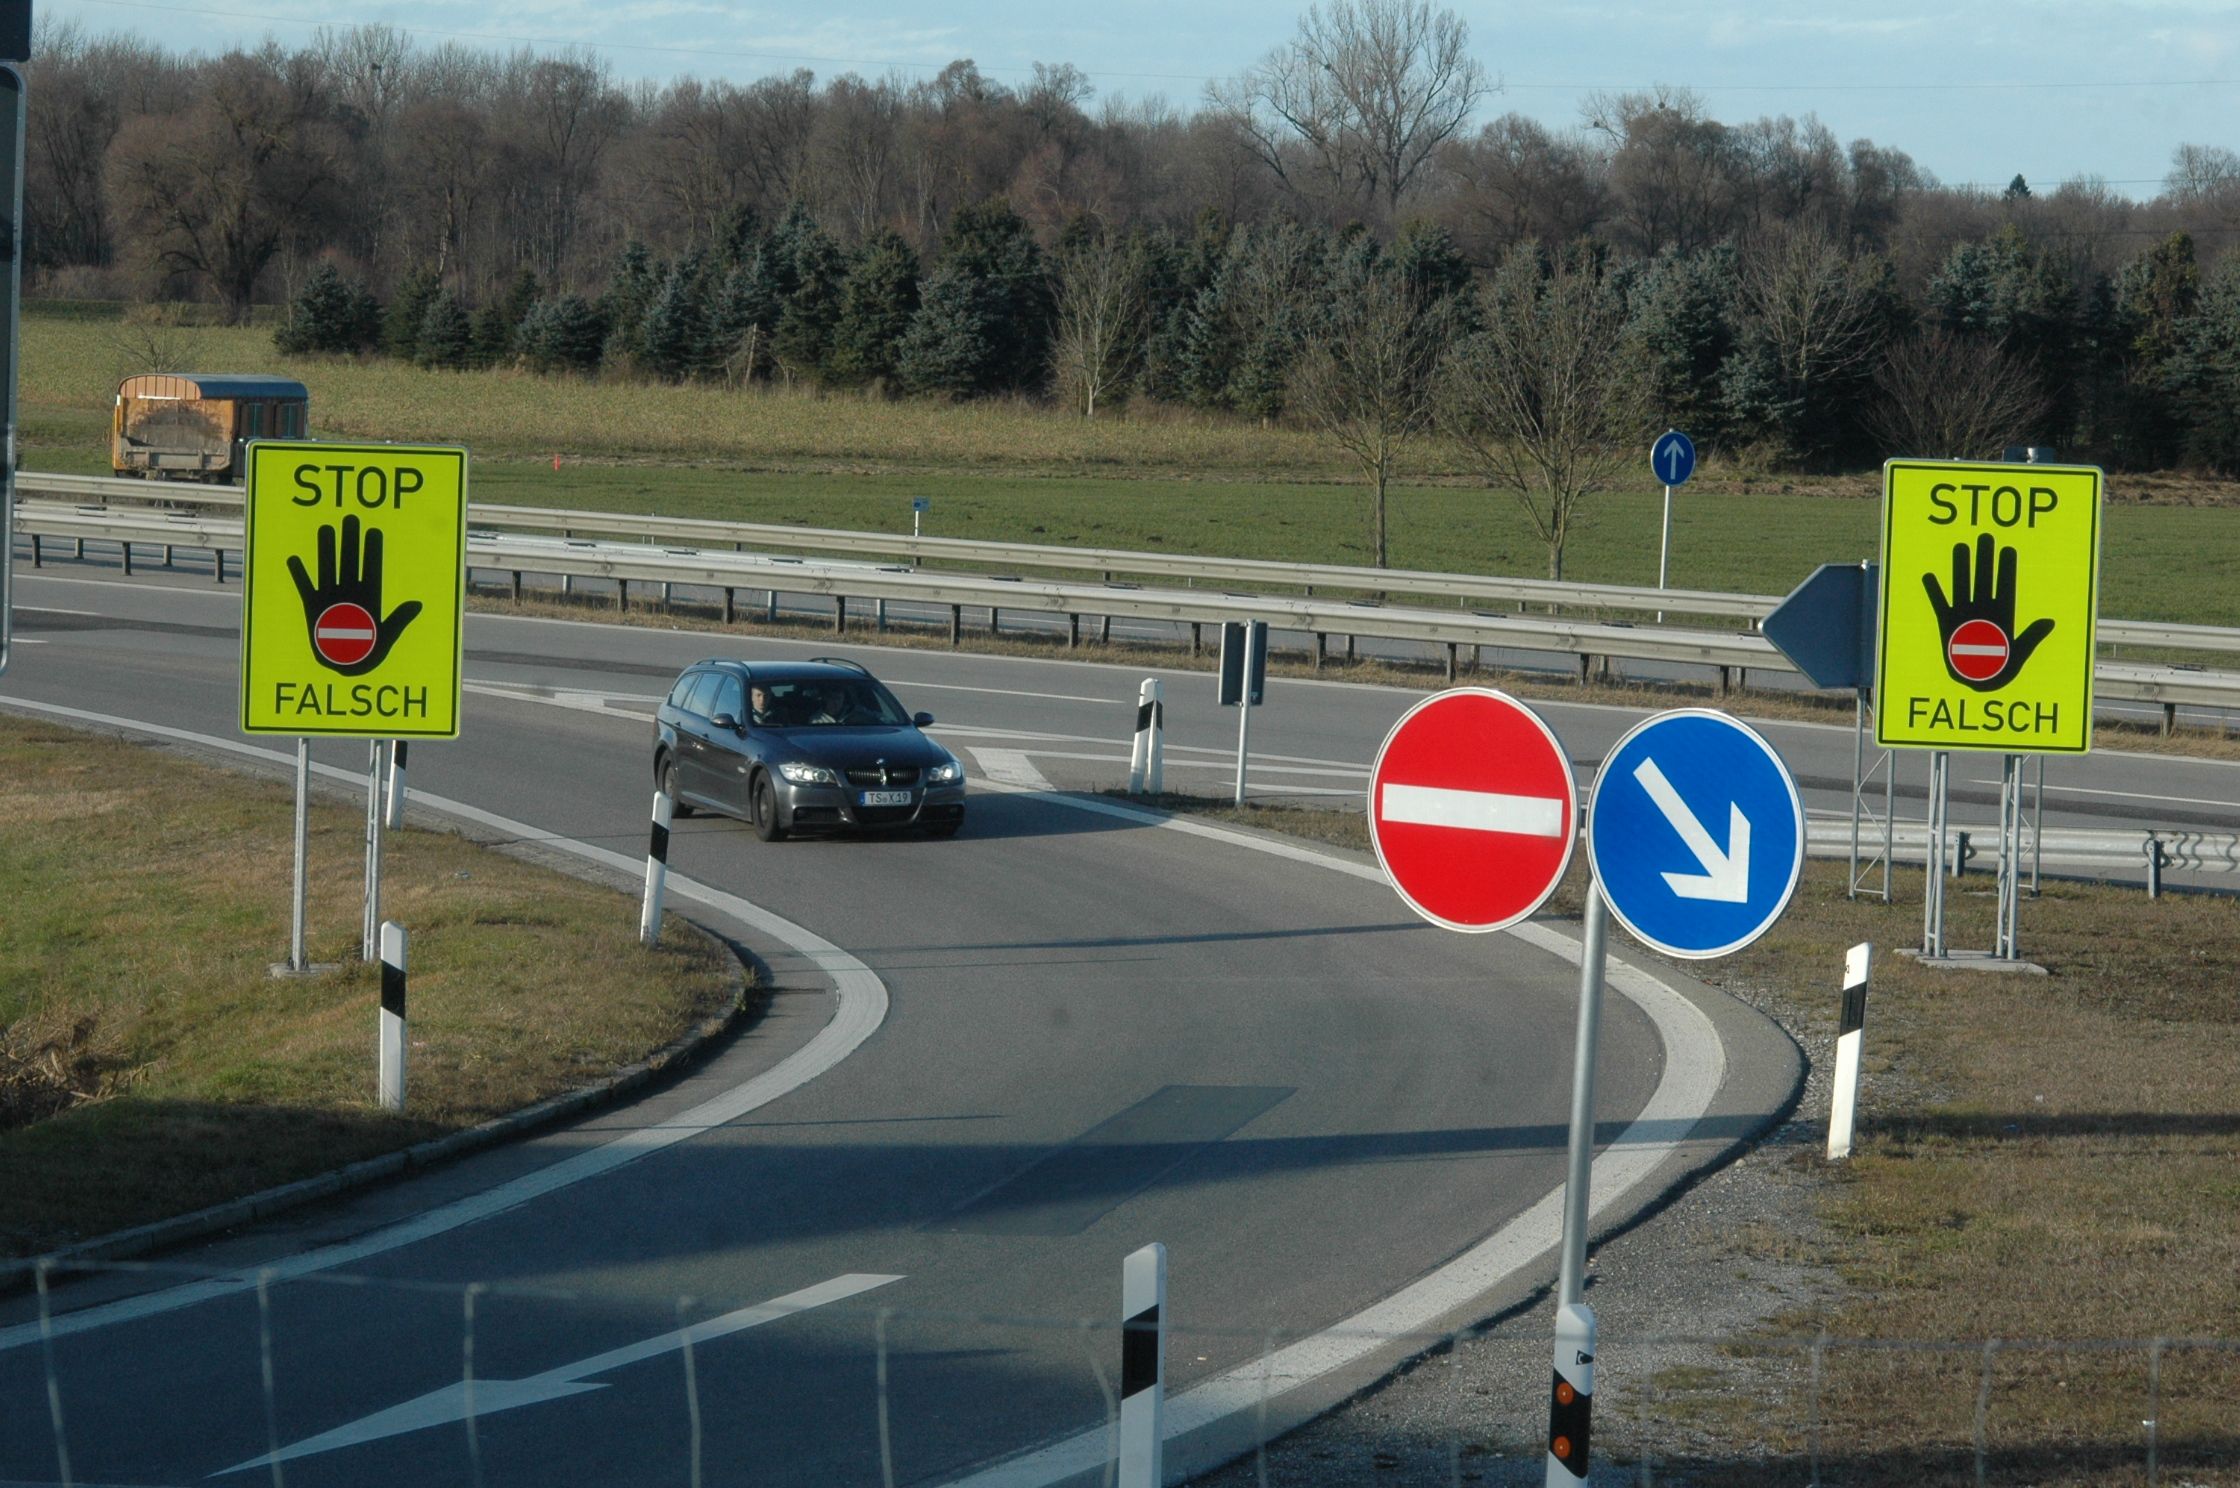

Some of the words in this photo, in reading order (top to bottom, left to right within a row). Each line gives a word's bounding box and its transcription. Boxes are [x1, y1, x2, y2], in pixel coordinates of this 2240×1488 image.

[292, 464, 424, 509] STOP
[1928, 483, 2058, 528] STOP
[275, 683, 427, 718] FALSCH
[1908, 697, 2058, 734] FALSCH
[869, 793, 882, 803] TS
